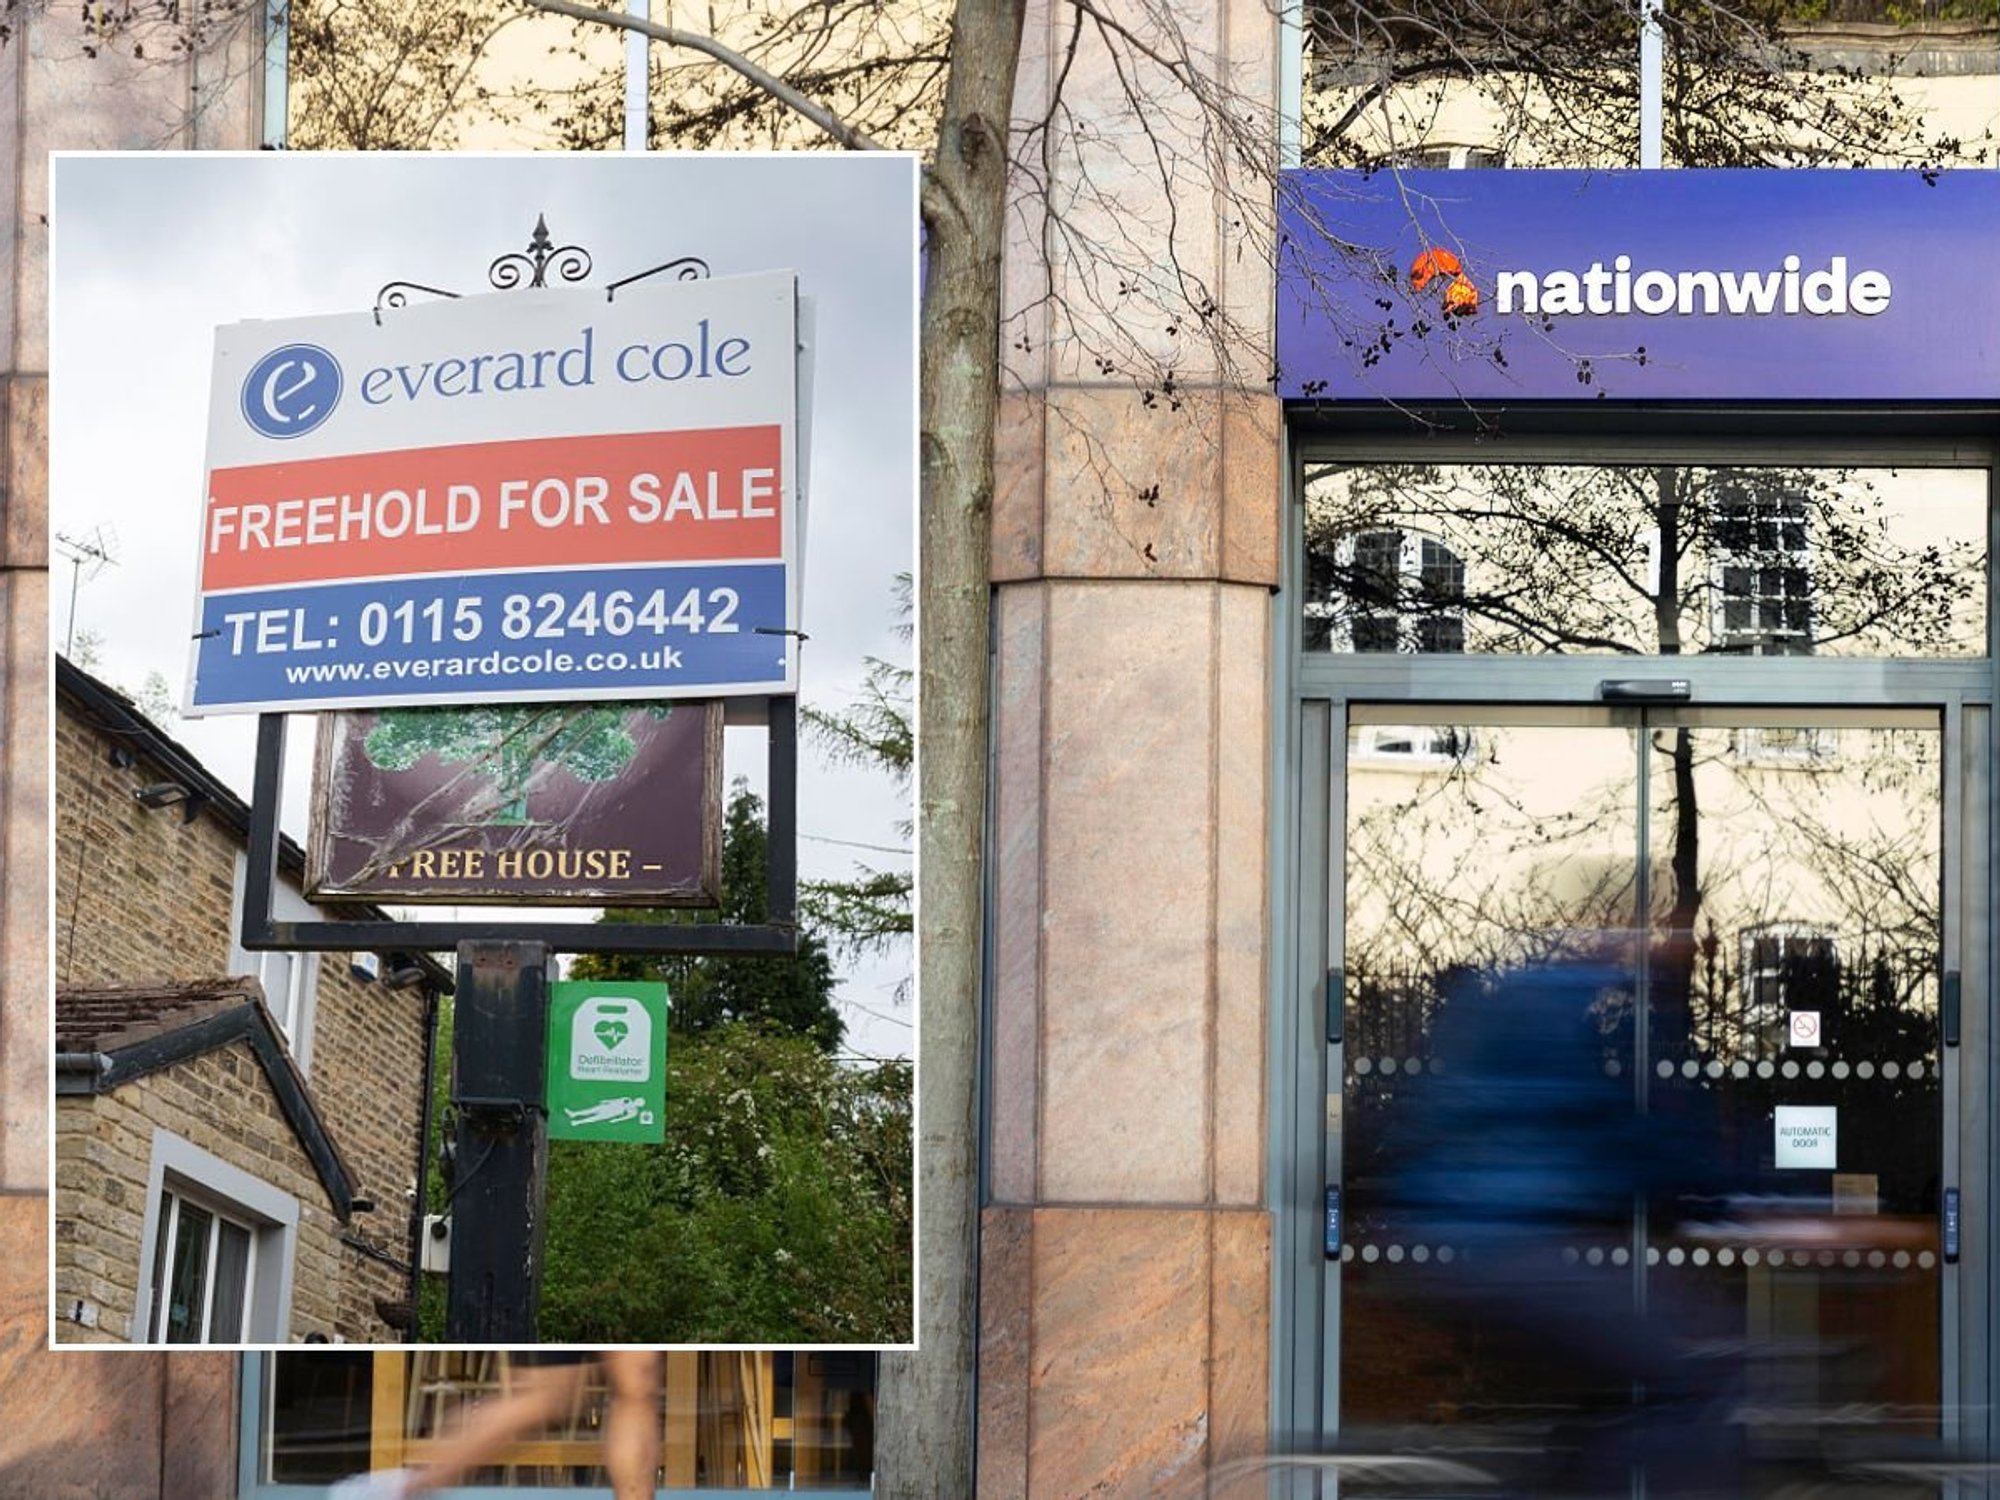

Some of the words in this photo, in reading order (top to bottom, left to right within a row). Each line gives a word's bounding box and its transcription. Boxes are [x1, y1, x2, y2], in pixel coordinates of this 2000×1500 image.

[1496, 254, 1892, 315] nationwide
[360, 326, 596, 406] everard
[615, 319, 753, 384] cole
[209, 484, 482, 556] FREEHOLD
[498, 475, 611, 532] FOR
[627, 467, 777, 526] SALE
[224, 607, 339, 656] TEL:
[359, 596, 484, 647] 0115
[500, 586, 740, 640] 8246442
[285, 645, 684, 685] www.everardcole.co.uk
[496, 849, 632, 880] HOUSE
[1779, 1126, 1832, 1137] AUTOMATIC
[1792, 1138, 1818, 1148] DOOR
